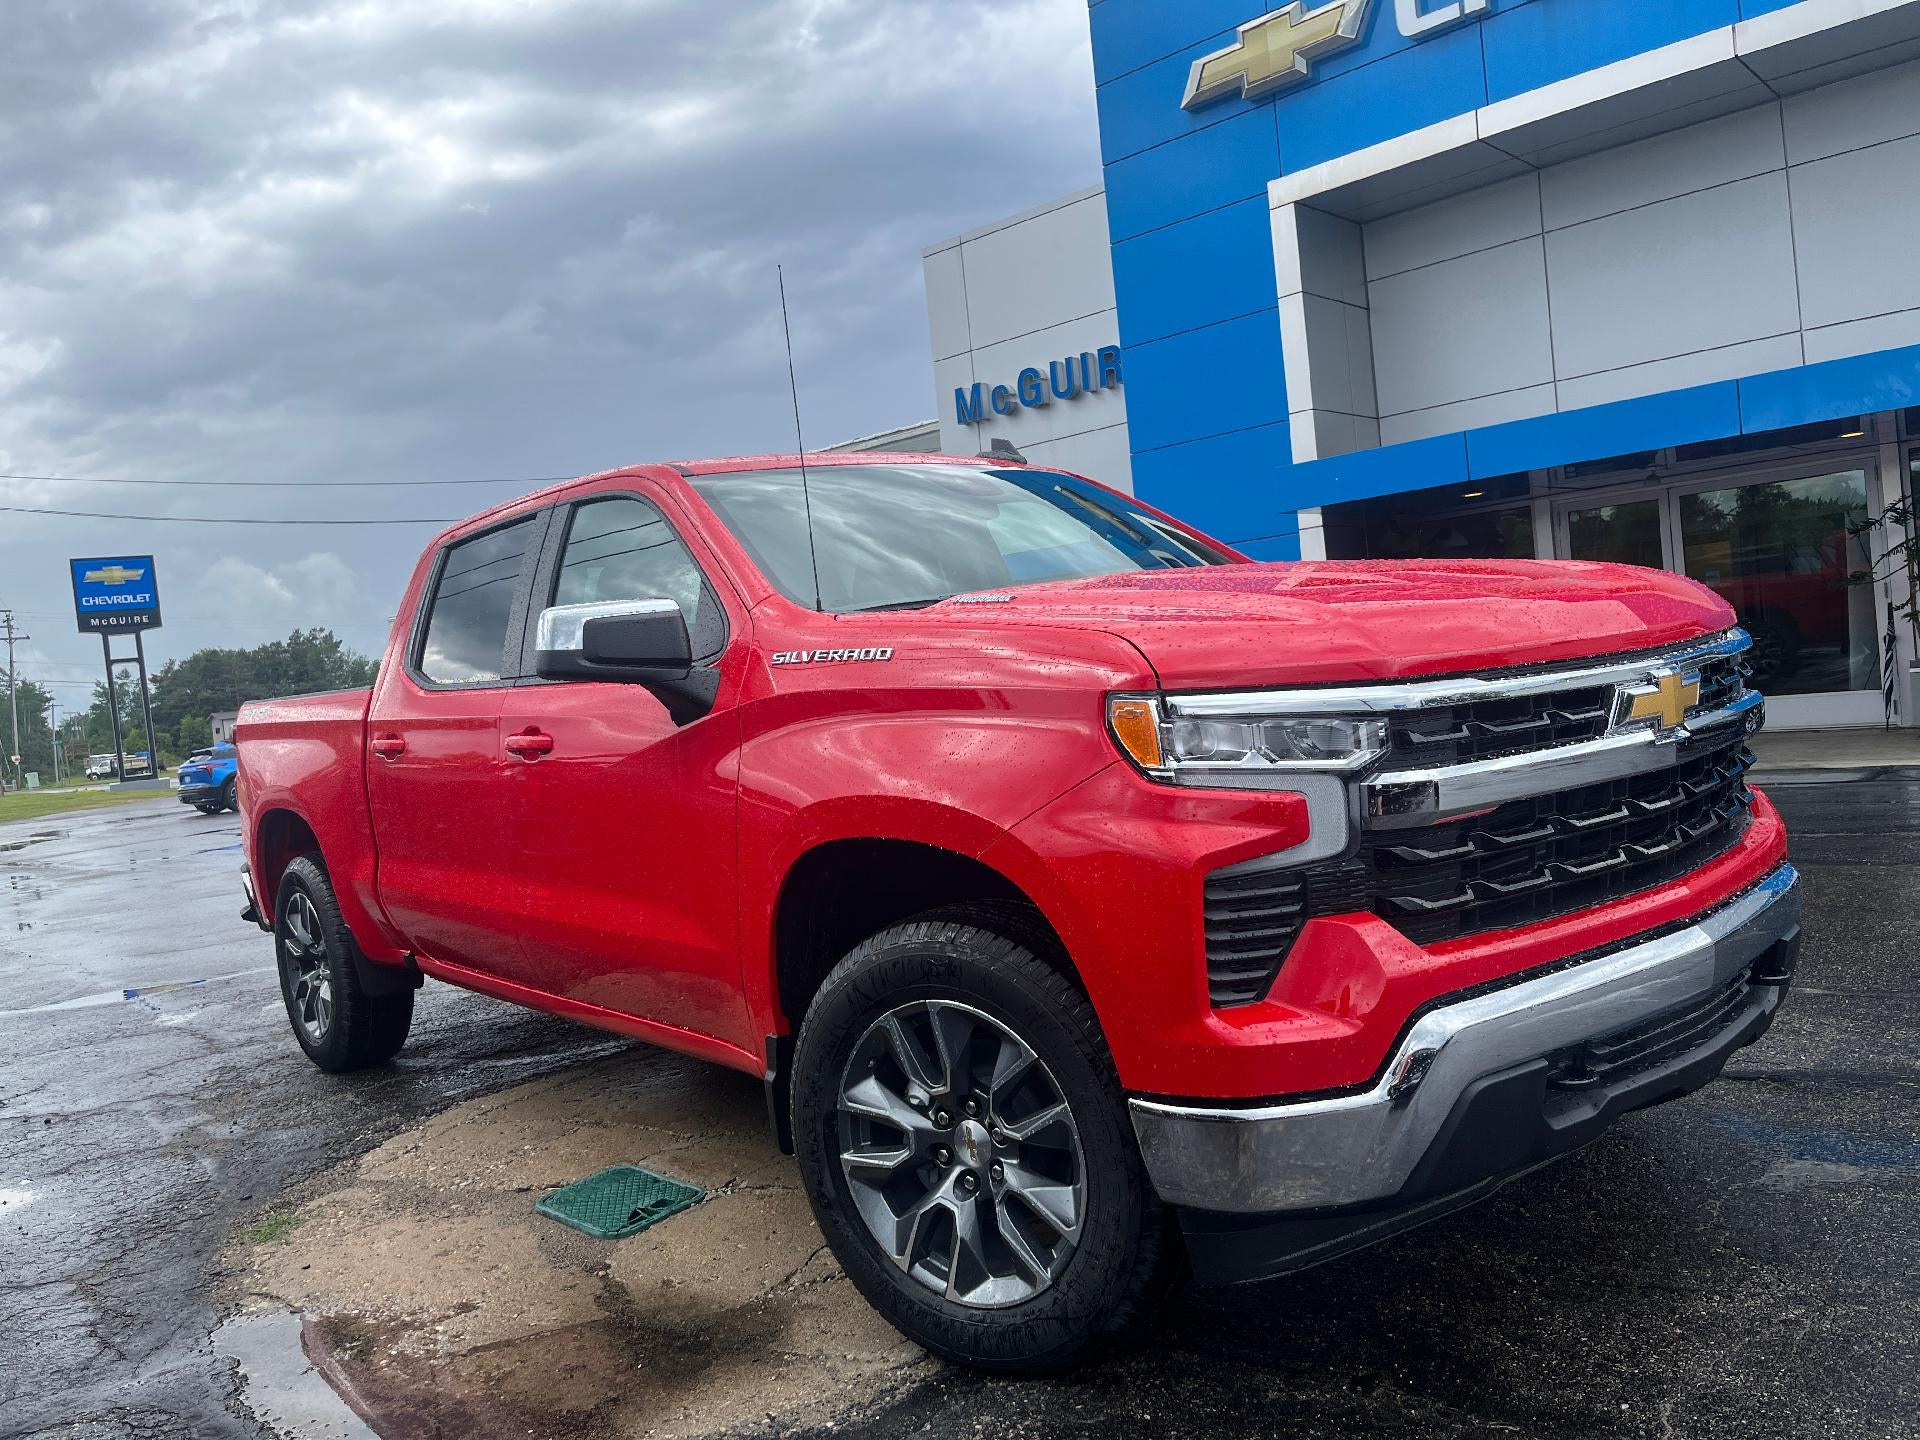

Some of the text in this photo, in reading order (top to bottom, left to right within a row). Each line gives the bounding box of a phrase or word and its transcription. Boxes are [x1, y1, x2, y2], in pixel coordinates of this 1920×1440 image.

[82, 593, 150, 606] CHEVROLET
[90, 615, 149, 626] McGUIRE
[771, 647, 893, 665] SILVERADO
